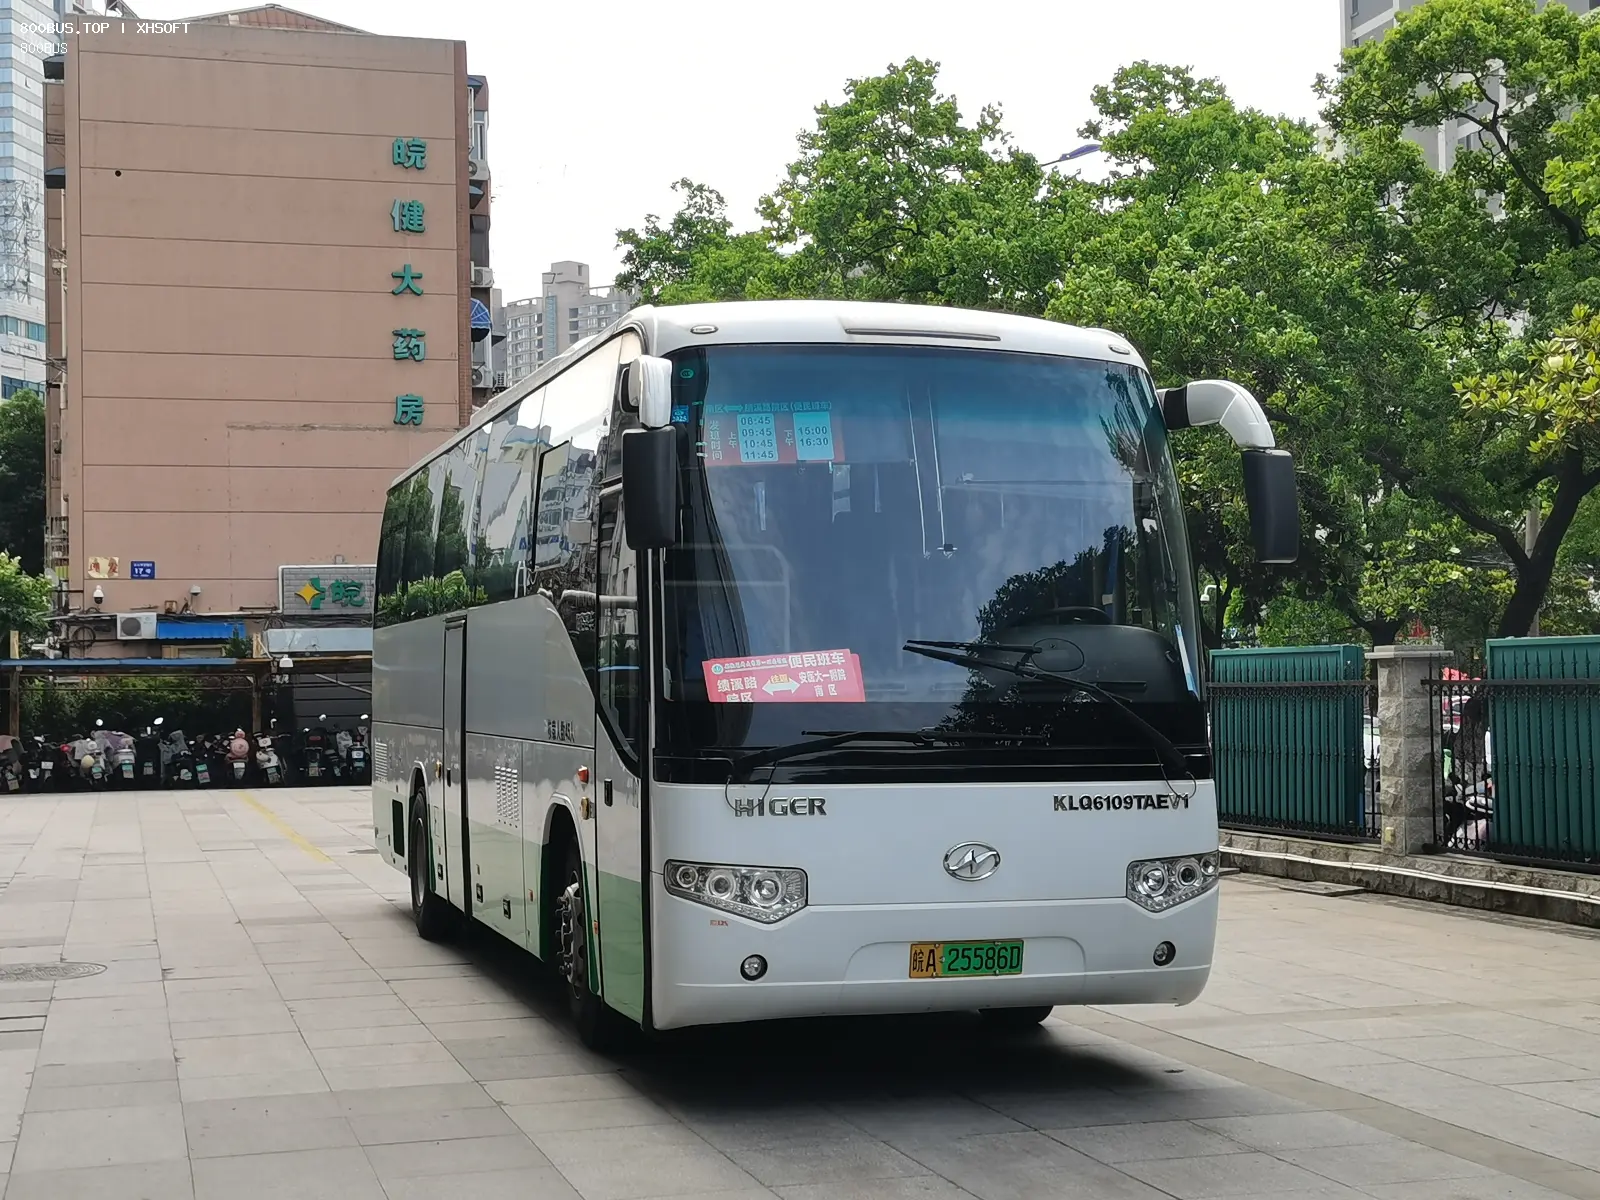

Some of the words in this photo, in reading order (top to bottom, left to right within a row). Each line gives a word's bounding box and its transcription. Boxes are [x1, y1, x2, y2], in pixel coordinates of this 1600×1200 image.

[391, 137, 428, 426] 皖健大药房
[740, 416, 771, 426] 08:45
[741, 428, 773, 438] 09:45
[798, 426, 828, 436] 15:00
[744, 439, 774, 449] 10:45
[800, 437, 829, 448] 16:30
[744, 450, 775, 460] 11:45
[788, 652, 846, 669] 便民班车
[717, 676, 758, 692] 绩溪路
[734, 796, 828, 818] HIGER
[1053, 792, 1190, 812] KLQ6109TAEV1
[912, 948, 937, 973] 皖A
[947, 946, 1022, 972] 25586D
